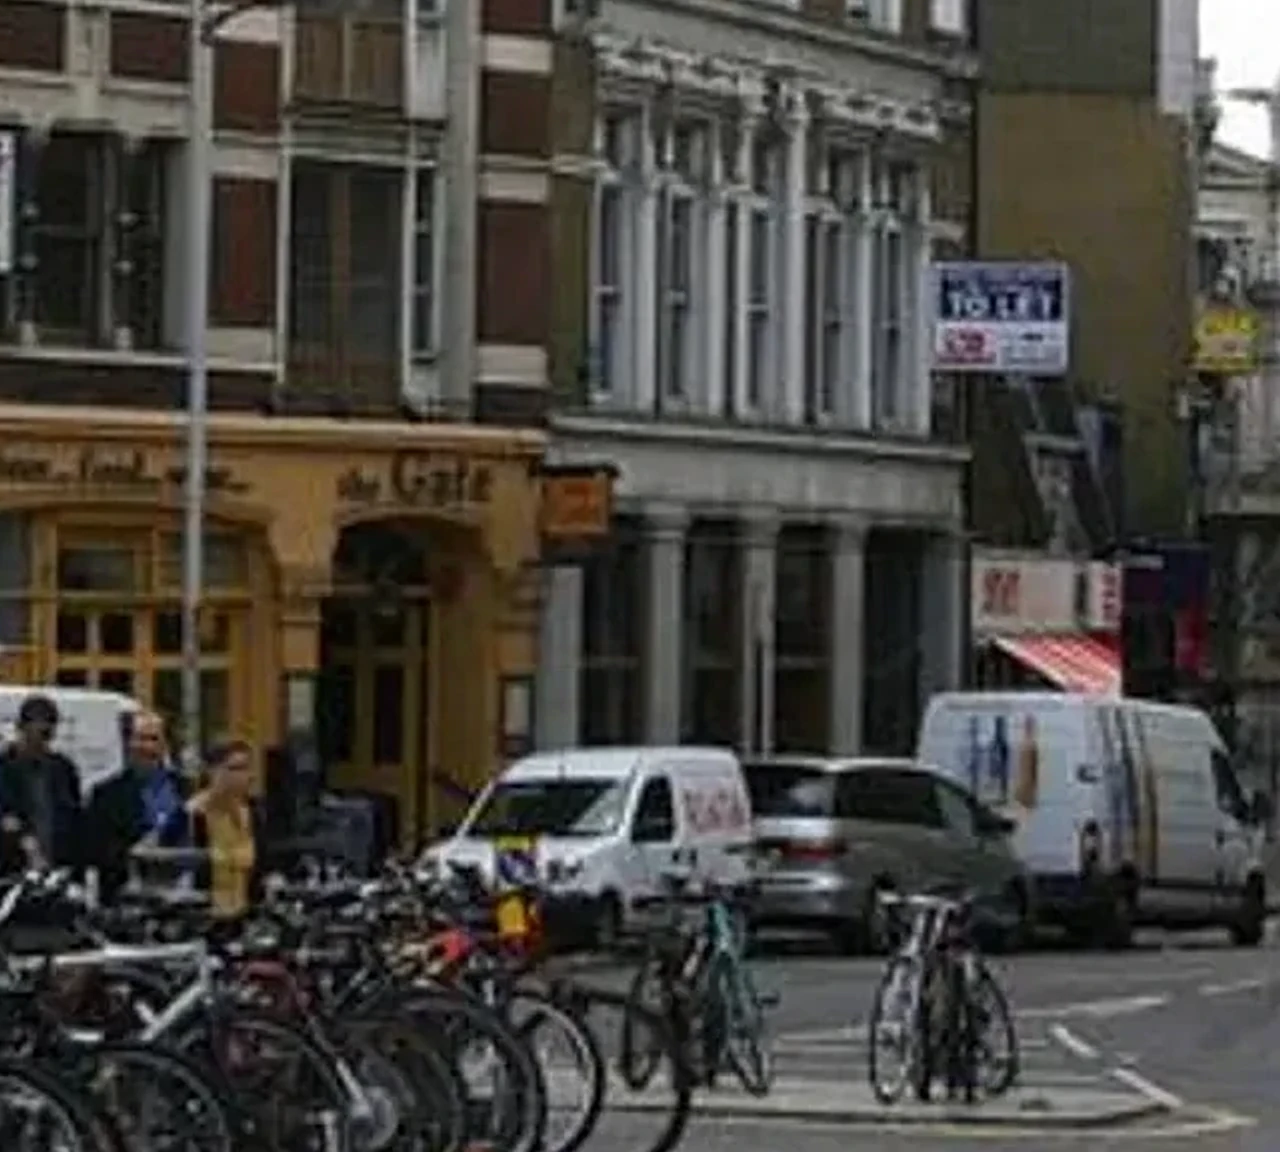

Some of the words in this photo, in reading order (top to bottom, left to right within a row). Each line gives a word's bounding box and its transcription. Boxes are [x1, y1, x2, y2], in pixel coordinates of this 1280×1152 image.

[947, 292, 990, 319] TO
[995, 292, 1054, 320] LET
[337, 465, 381, 500] the
[393, 446, 495, 508] Gate
